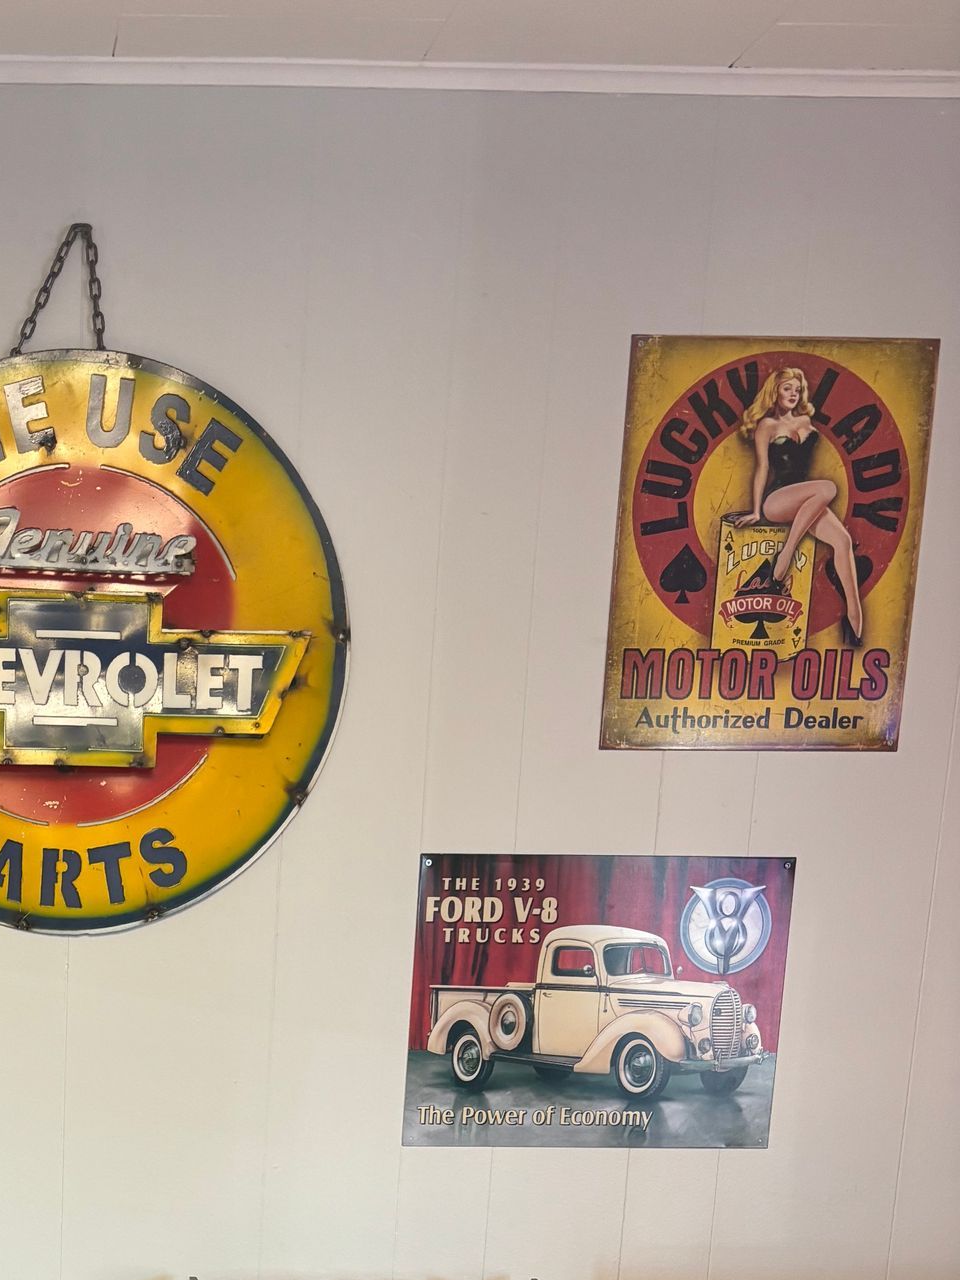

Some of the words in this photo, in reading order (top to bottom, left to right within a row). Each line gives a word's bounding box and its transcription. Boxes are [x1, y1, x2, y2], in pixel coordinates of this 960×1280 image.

[86, 373, 244, 496] USE
[640, 360, 759, 536] LUCKY
[809, 367, 904, 537] LADY
[724, 531, 734, 542] A
[726, 597, 772, 615] MOTOR
[776, 598, 796, 615] OIL
[732, 638, 761, 646] PREMIUM
[763, 638, 786, 646] GRADE
[620, 647, 777, 701] MOTOR
[791, 647, 890, 701] OILS
[635, 706, 771, 735] Authorized
[783, 706, 865, 731] Dealer
[442, 877, 481, 892] THE
[495, 877, 546, 892] 1939
[424, 895, 504, 924] FORD
[513, 896, 559, 924] V-8
[442, 927, 541, 945] TRUCKS
[417, 1105, 455, 1126] The
[460, 1106, 529, 1127] Power
[532, 1105, 556, 1126] of
[559, 1107, 655, 1132] Economy
